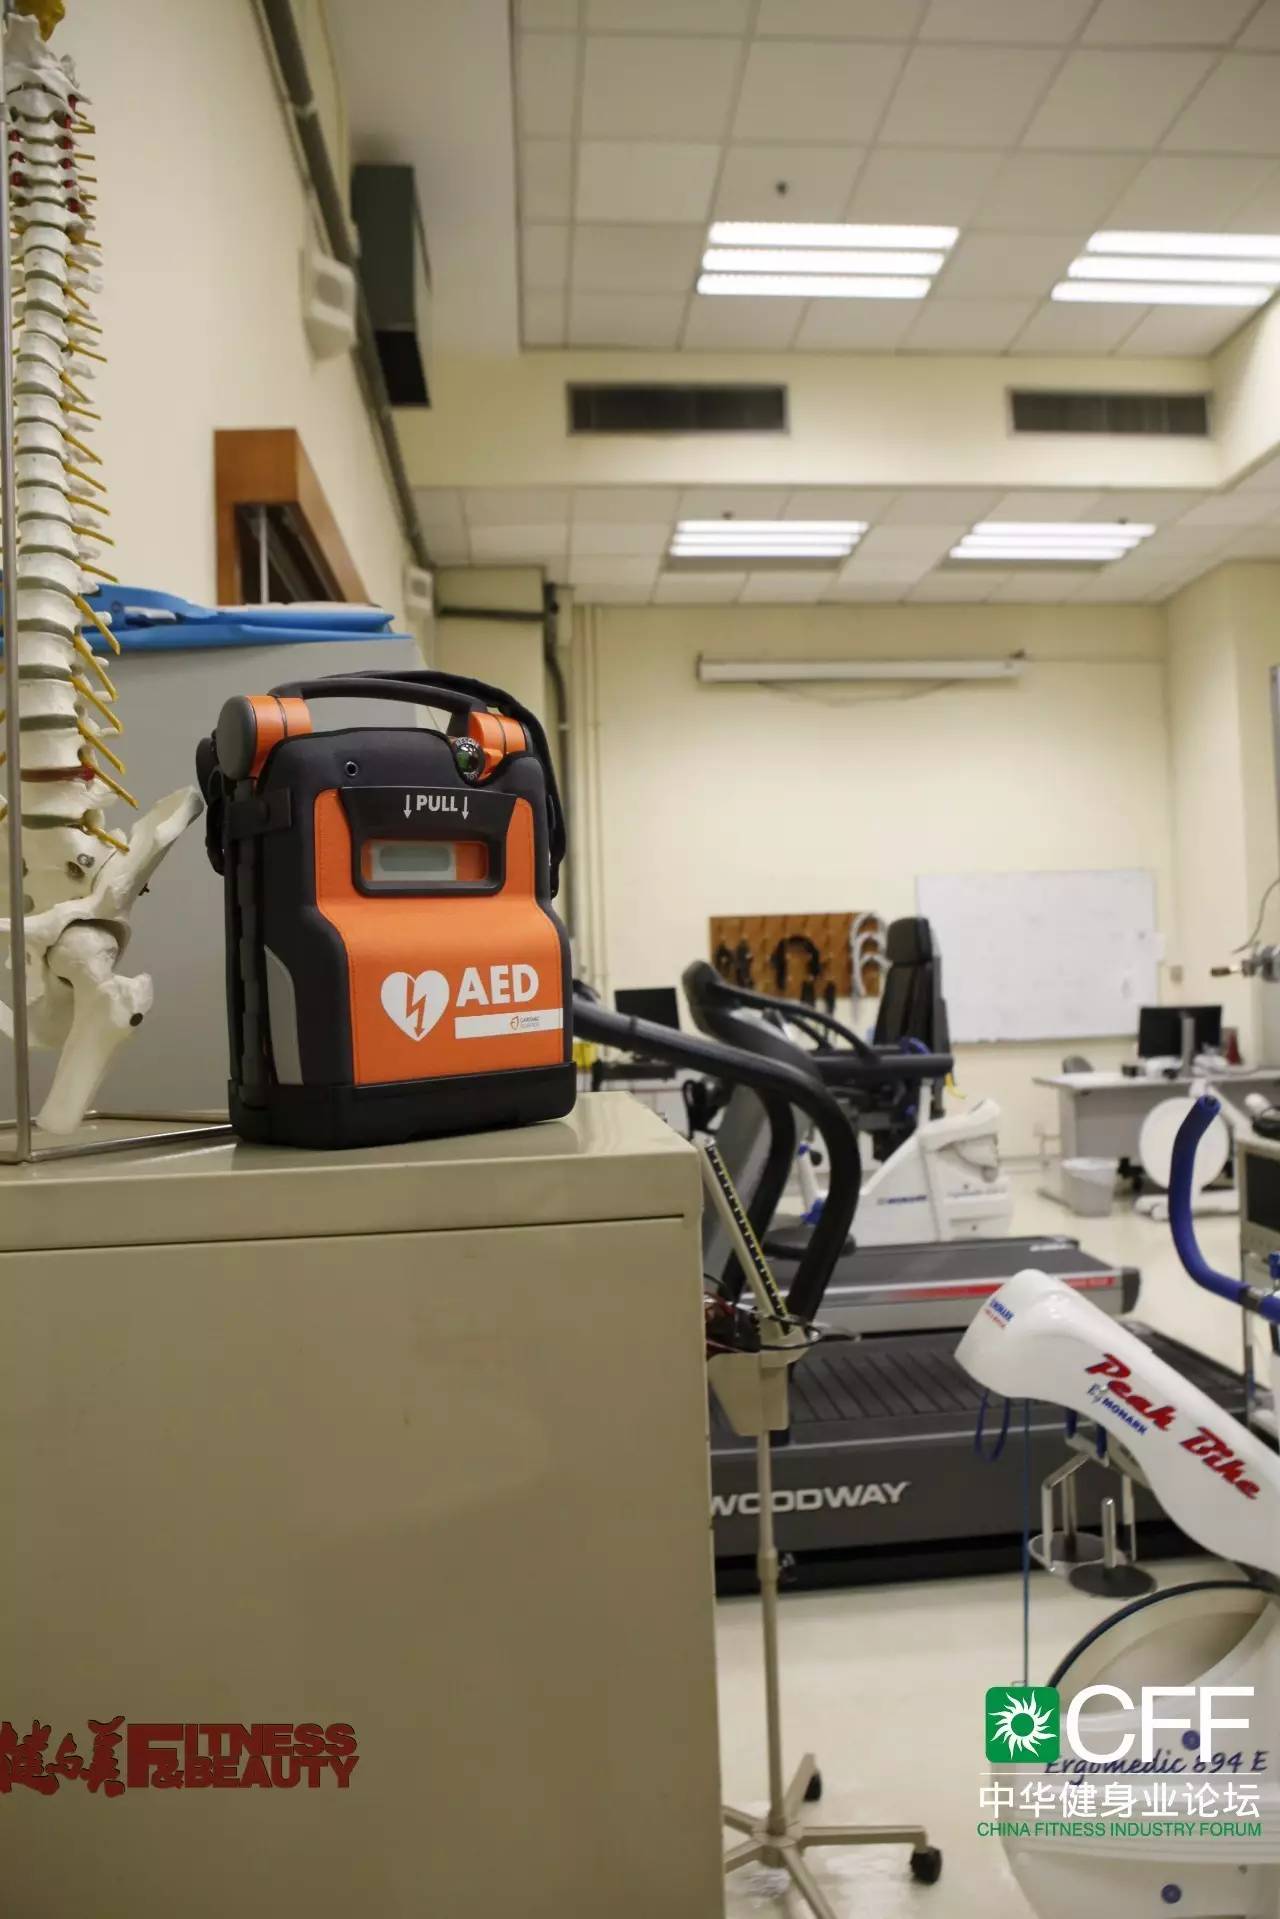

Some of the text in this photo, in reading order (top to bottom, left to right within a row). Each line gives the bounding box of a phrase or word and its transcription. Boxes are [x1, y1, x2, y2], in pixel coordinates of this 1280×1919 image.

[416, 794, 458, 812] PULL
[455, 963, 540, 1008] AED
[1085, 1353, 1260, 1500] Peak Bike
[1102, 1398, 1148, 1436] MONARK
[711, 1481, 911, 1517] WOODWAY
[1250, 1750, 1270, 1772] E
